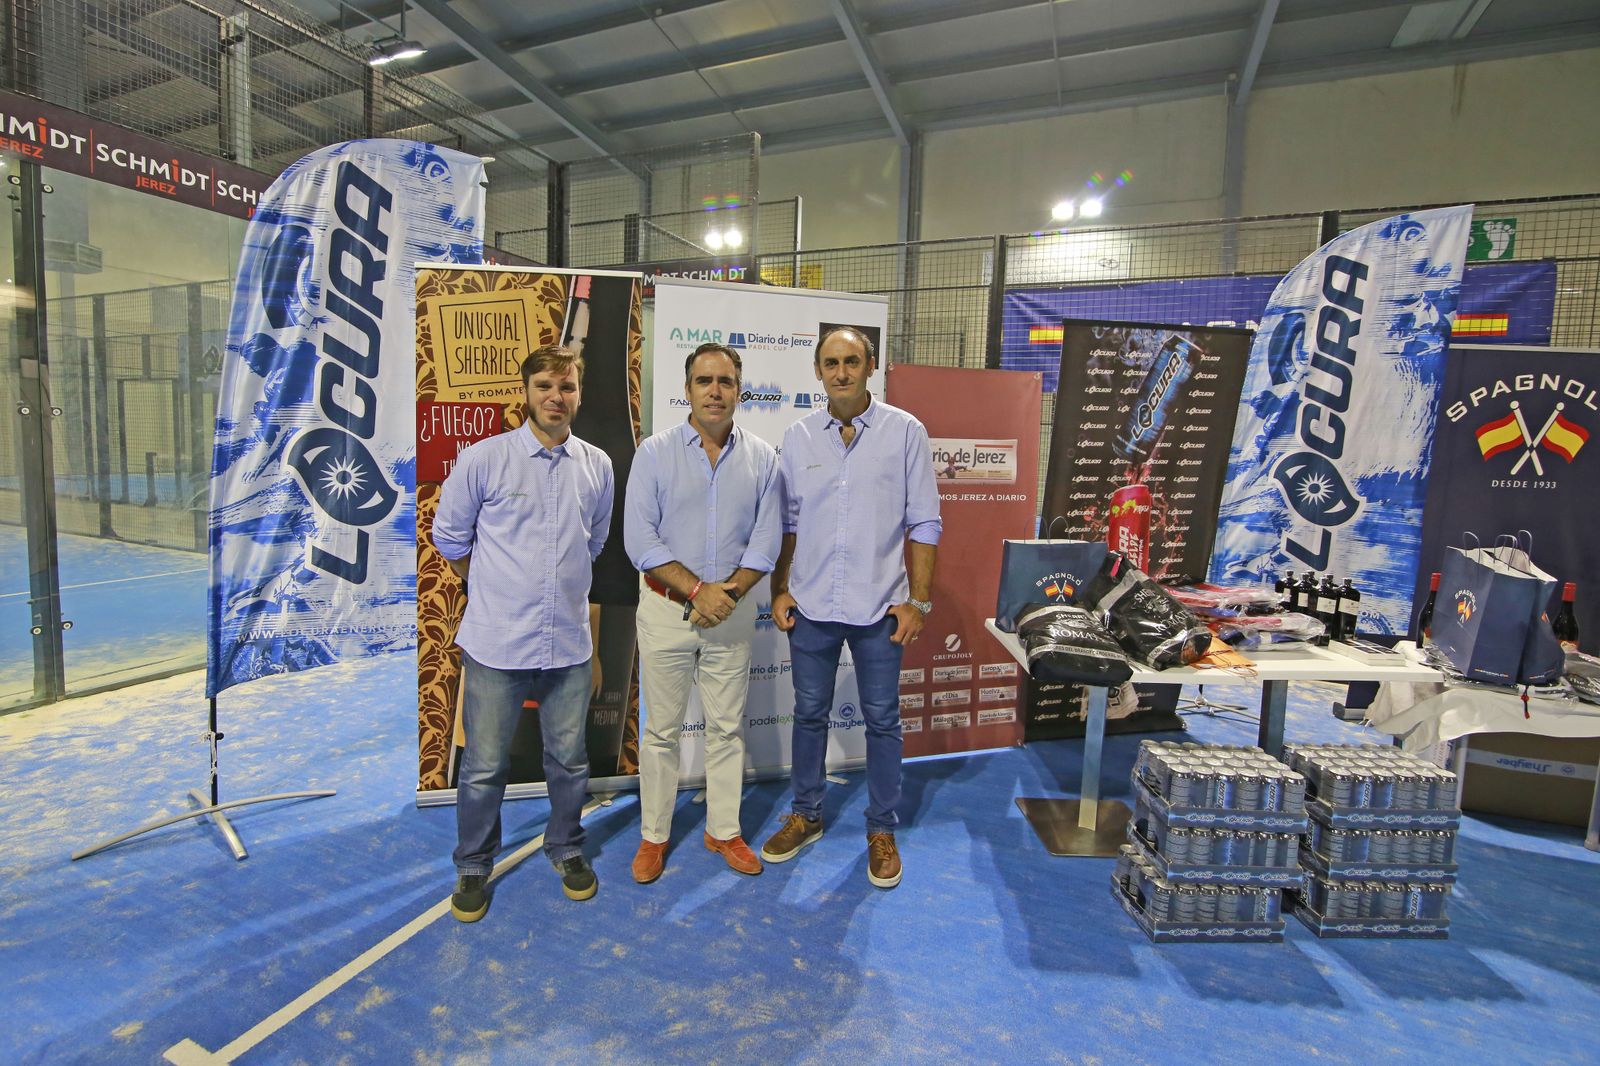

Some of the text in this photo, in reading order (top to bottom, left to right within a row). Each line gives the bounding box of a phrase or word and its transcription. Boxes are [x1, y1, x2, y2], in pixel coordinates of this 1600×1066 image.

[136, 175, 177, 196] JEREZ
[217, 179, 263, 205] SCH
[454, 312, 521, 342] UNUSUAL
[687, 328, 722, 343] MAR
[748, 333, 812, 348] Diario de Jerez
[1090, 349, 1116, 357] LOCURA
[454, 347, 520, 376] SHERRIES
[1087, 367, 1115, 375] LOCURA
[1085, 385, 1112, 394] LOCURA
[1188, 389, 1215, 397] LOCURA
[459, 391, 474, 400] BY
[1082, 404, 1109, 412] LOCURA
[1186, 407, 1212, 415] LOCURA
[420, 405, 495, 442] ¿FUEGO?
[1080, 422, 1107, 430] LOCURA
[1183, 424, 1208, 432] LOCURA
[1077, 440, 1105, 448] LOCURA
[1179, 441, 1205, 449] LOCURA
[954, 448, 970, 464] de
[972, 448, 1006, 467] Jerez
[1074, 457, 1101, 465] LOCURA
[1072, 475, 1099, 483] LOCURA
[1173, 475, 1199, 483] LOCURA
[1491, 480, 1557, 489] DESDE 1933
[1069, 492, 1096, 500] LOCURA
[1170, 492, 1196, 500] LOCURA
[768, 664, 778, 673] de
